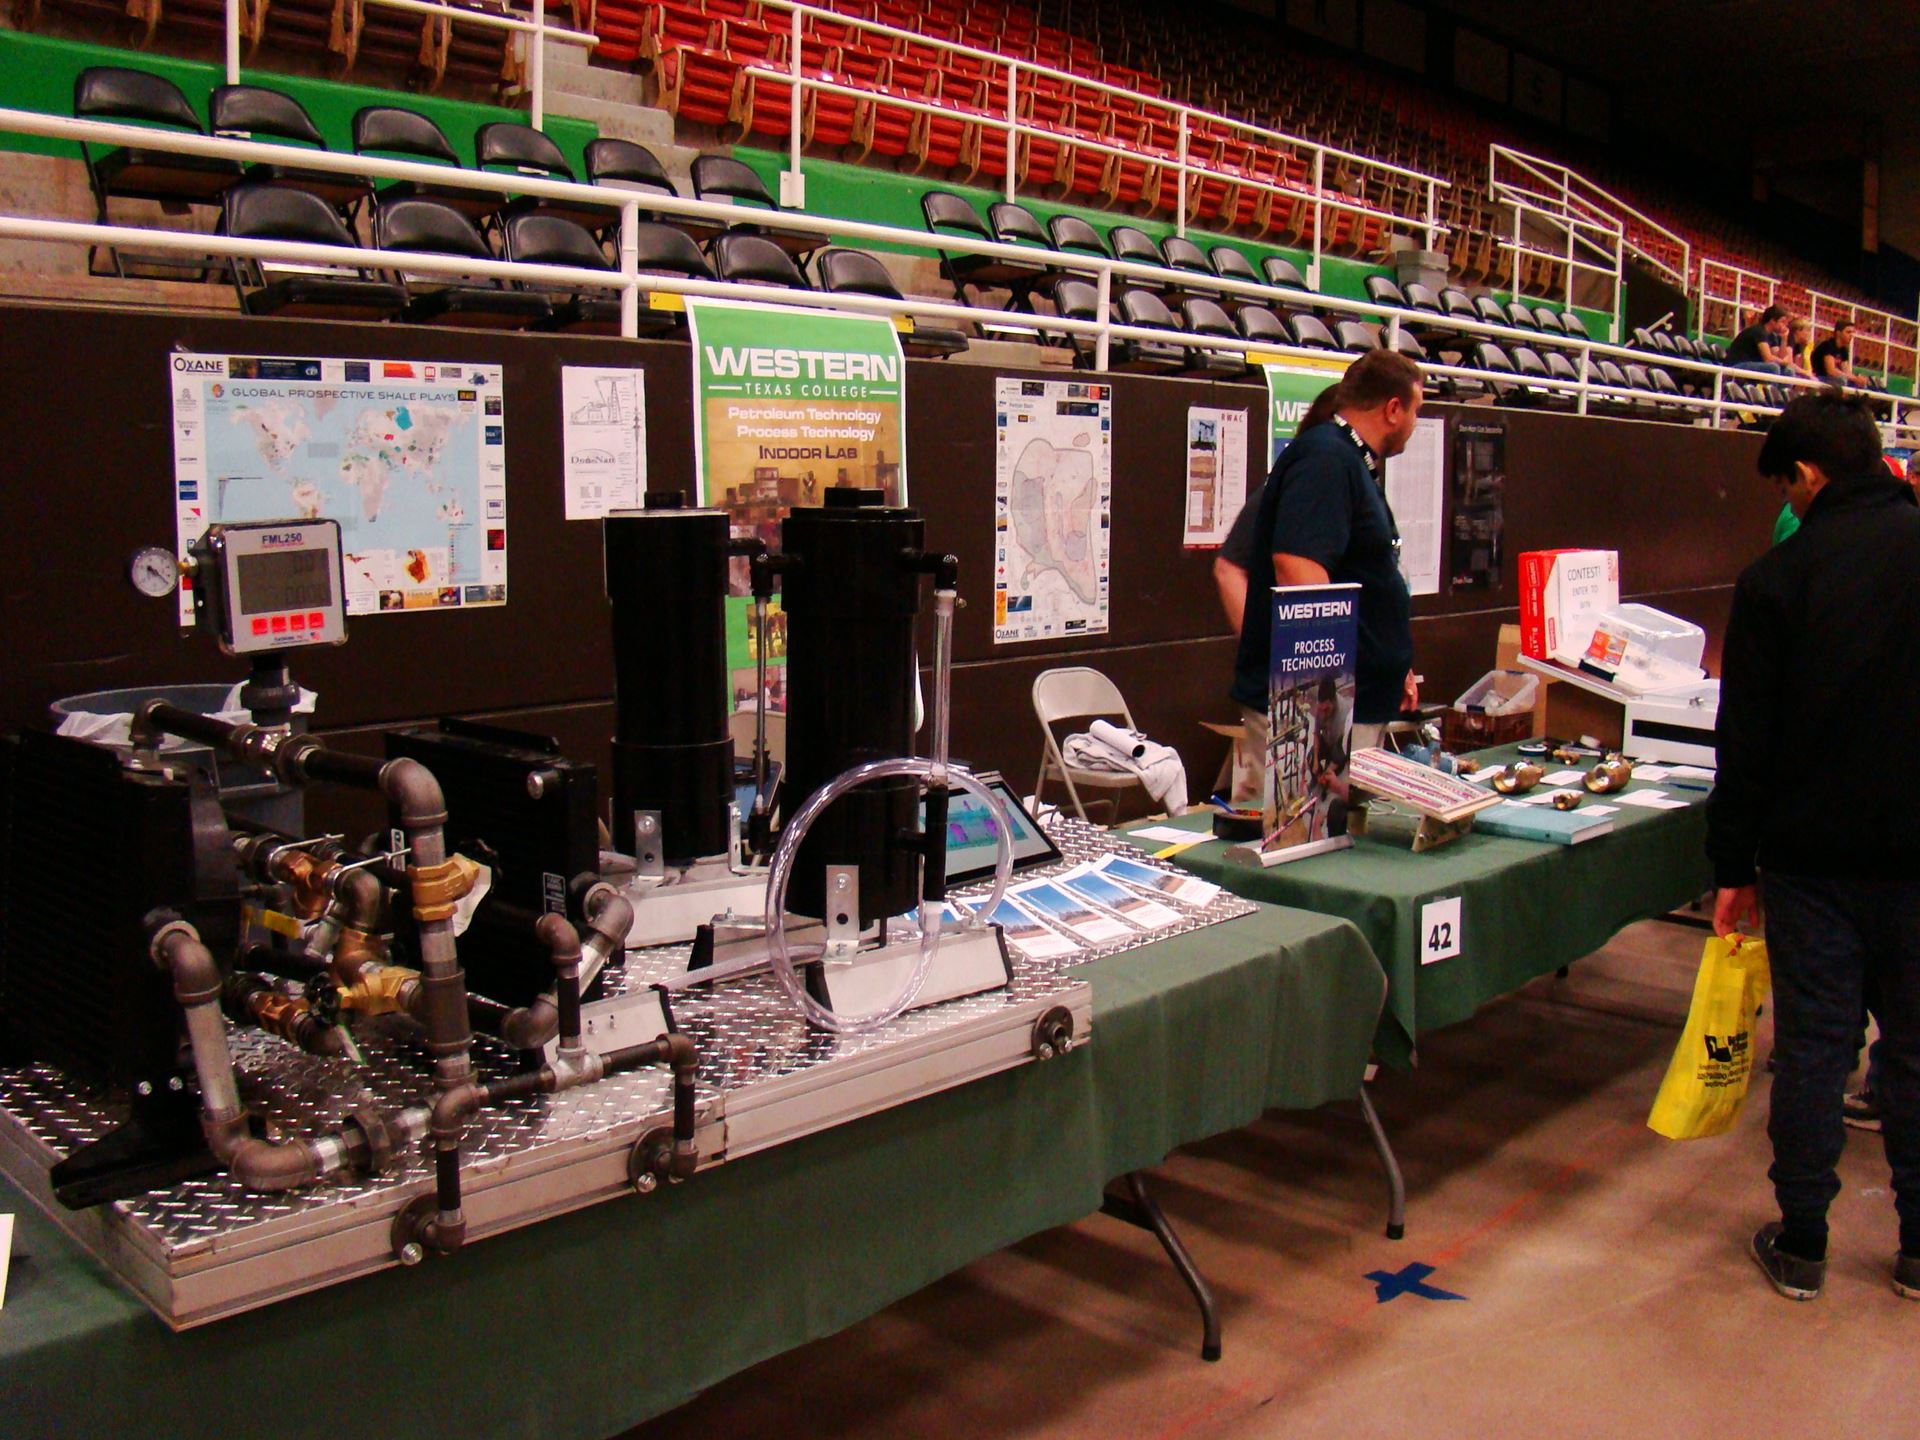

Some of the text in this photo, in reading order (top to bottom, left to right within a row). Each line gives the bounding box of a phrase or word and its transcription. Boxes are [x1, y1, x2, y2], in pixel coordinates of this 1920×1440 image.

[174, 357, 223, 372] OXANE
[705, 345, 897, 382] WESTERN
[232, 387, 284, 397] GLOBAL
[288, 389, 375, 400] PROSPECTIVE
[378, 391, 416, 400] SHALE
[420, 392, 456, 401] PLAYS
[744, 383, 867, 398] TEXAS COLLEGE
[728, 406, 881, 424] Petroleum Technology
[736, 425, 875, 441] Process Technology
[759, 445, 858, 460] INDOOR LAB
[262, 533, 302, 544] FML250
[1567, 565, 1601, 581] CONTEST!
[1278, 600, 1352, 620] WESTERN
[1294, 638, 1335, 654] PROCESS
[1281, 653, 1346, 672] TECHNOLOGY
[1428, 922, 1452, 952] 42
